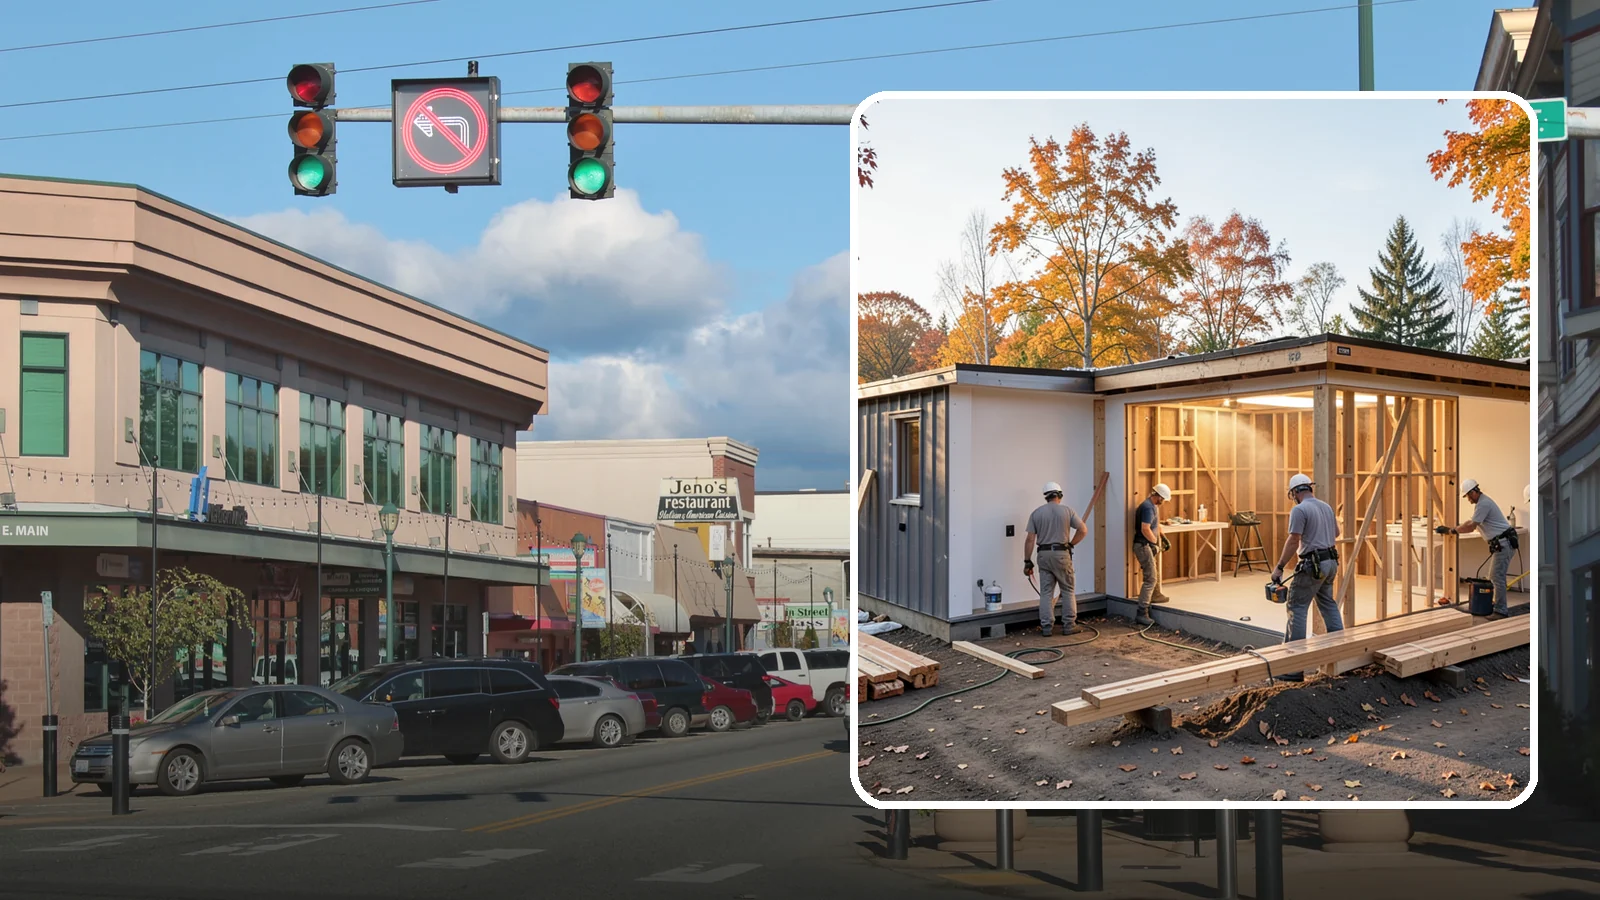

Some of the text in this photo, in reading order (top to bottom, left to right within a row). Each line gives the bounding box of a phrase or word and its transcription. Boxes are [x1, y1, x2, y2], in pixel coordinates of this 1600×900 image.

[669, 480, 728, 495] Jeno's
[665, 496, 731, 509] restaurant
[658, 510, 681, 519] Italian
[686, 509, 714, 519] American
[715, 509, 738, 519] Cuisine
[2, 525, 49, 536] E. MAIN
[785, 606, 796, 617] in
[797, 607, 828, 617] Street
[790, 620, 824, 628] lass
